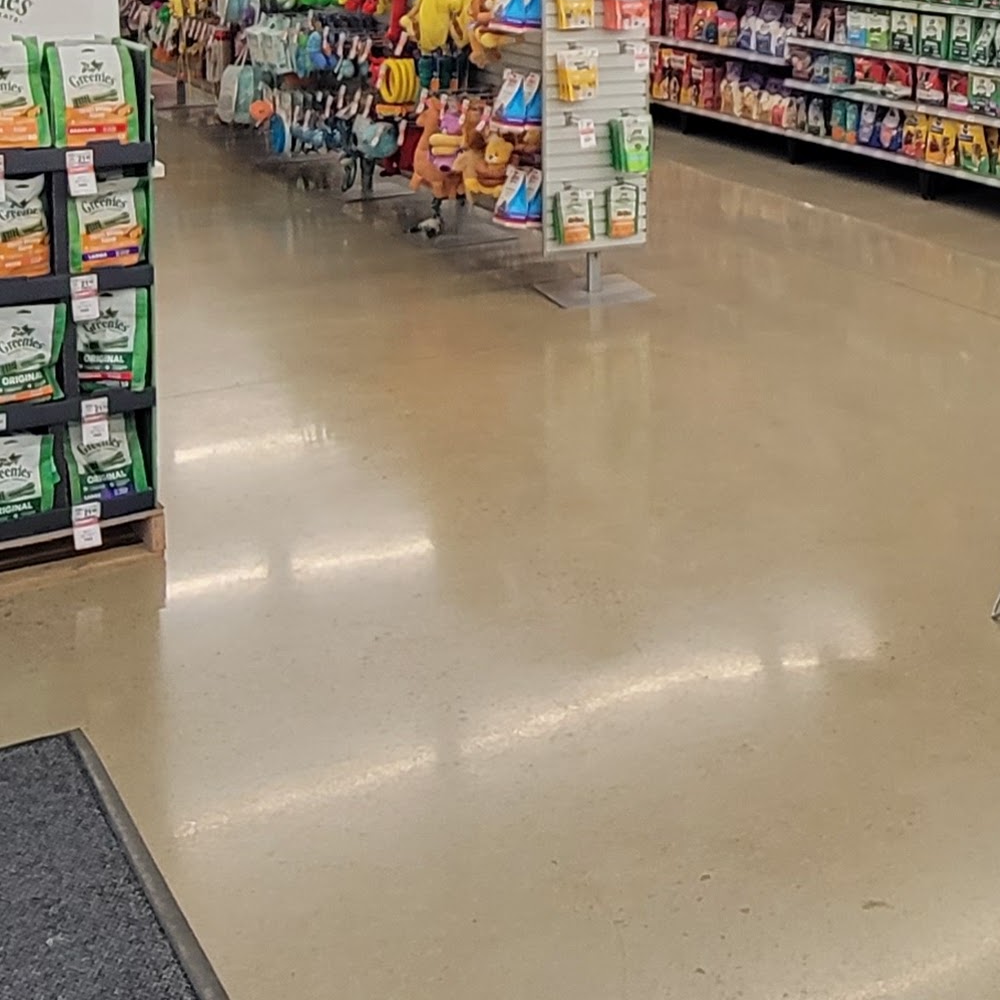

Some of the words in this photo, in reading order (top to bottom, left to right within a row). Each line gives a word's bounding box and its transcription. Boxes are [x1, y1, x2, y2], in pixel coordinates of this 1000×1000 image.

[68, 71, 116, 89] Greenies
[84, 354, 124, 363] ORIGINAL
[87, 470, 127, 484] ORIGINAL
